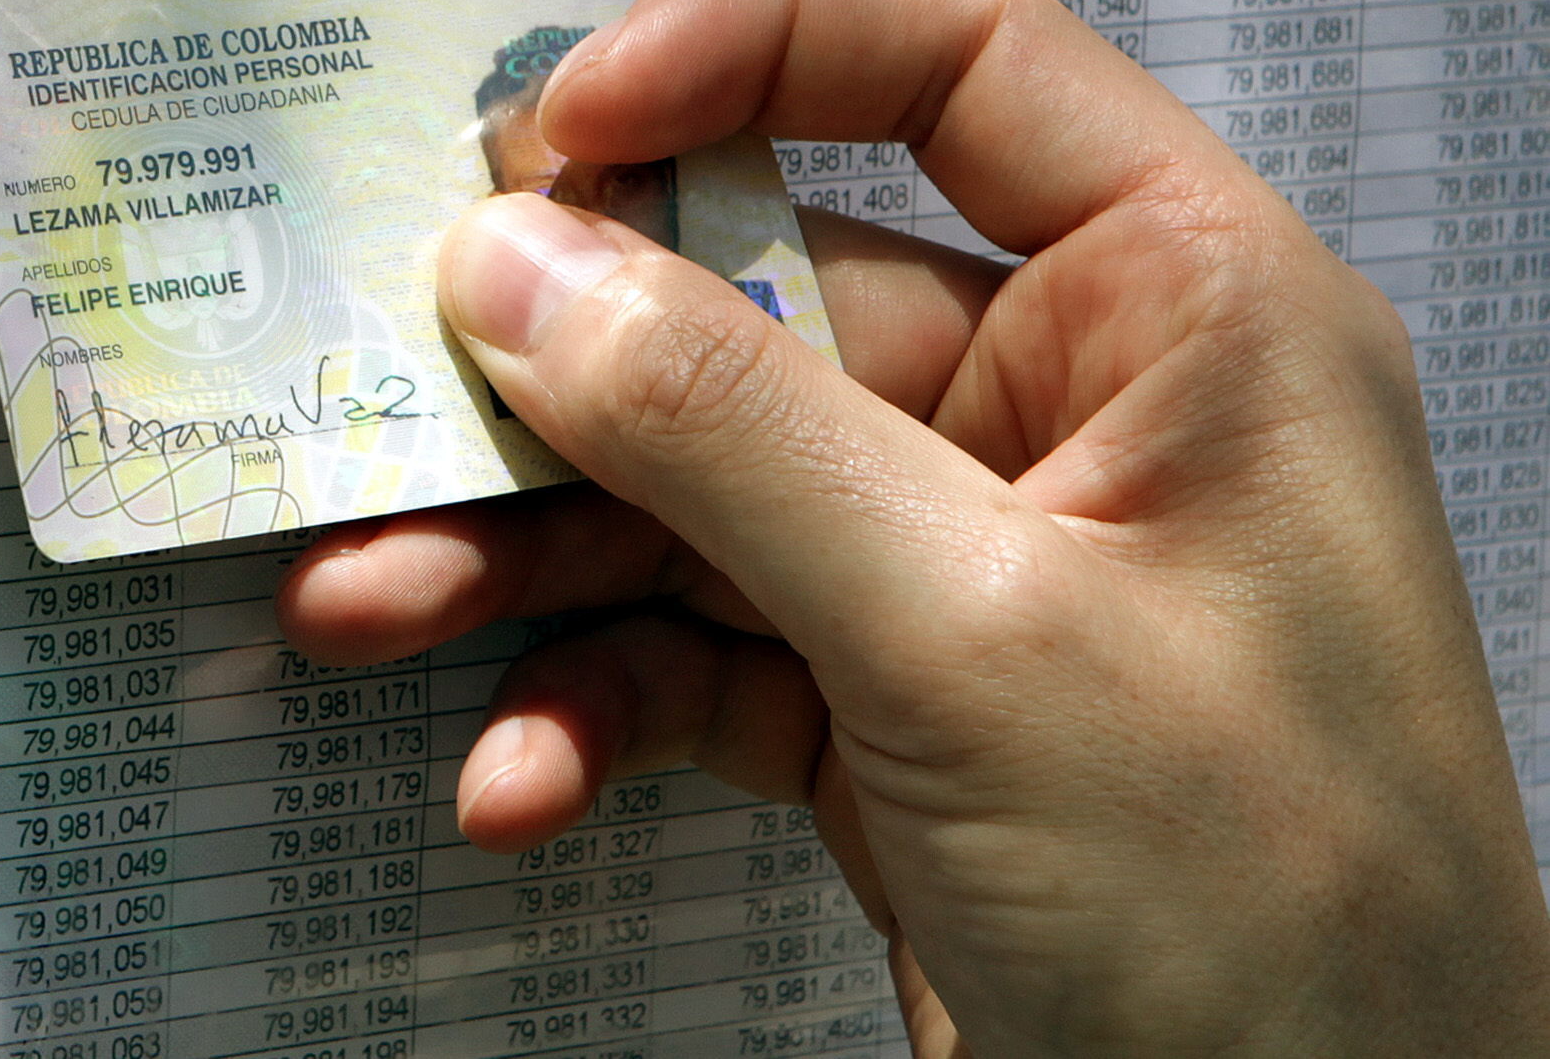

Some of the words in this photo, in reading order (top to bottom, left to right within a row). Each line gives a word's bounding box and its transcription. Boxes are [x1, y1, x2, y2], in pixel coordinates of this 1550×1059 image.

[8, 39, 168, 79] REPUBLICA
[173, 33, 213, 61] DE
[222, 16, 371, 56] COLOMBIA
[28, 65, 228, 106] IDENTIFICACION
[234, 49, 373, 84] PERSONAL
[71, 103, 162, 131] CEDULA
[166, 99, 198, 120] DE
[203, 83, 340, 117] CIUDADANIA
[4, 175, 76, 196] NUMERO
[96, 143, 255, 186] 79.979.991
[14, 203, 121, 235] LEZAMA
[126, 184, 282, 221] VILLAMIZAR
[22, 256, 112, 282] APELLIDOS
[31, 286, 122, 316] FELIPE
[128, 271, 246, 306] ENRIQUE
[38, 343, 124, 368] NOMBRES
[231, 449, 283, 468] FIRMA
[25, 573, 172, 619] 79,981,031
[23, 665, 177, 713] 79,981,037
[279, 681, 419, 725] 79,981,171
[18, 756, 170, 803] 79,981,045
[273, 772, 422, 814] 79,981,179
[15, 848, 167, 895] 79,981,049
[14, 894, 165, 940] 79,981,050
[264, 995, 409, 1042] 79,981,194
